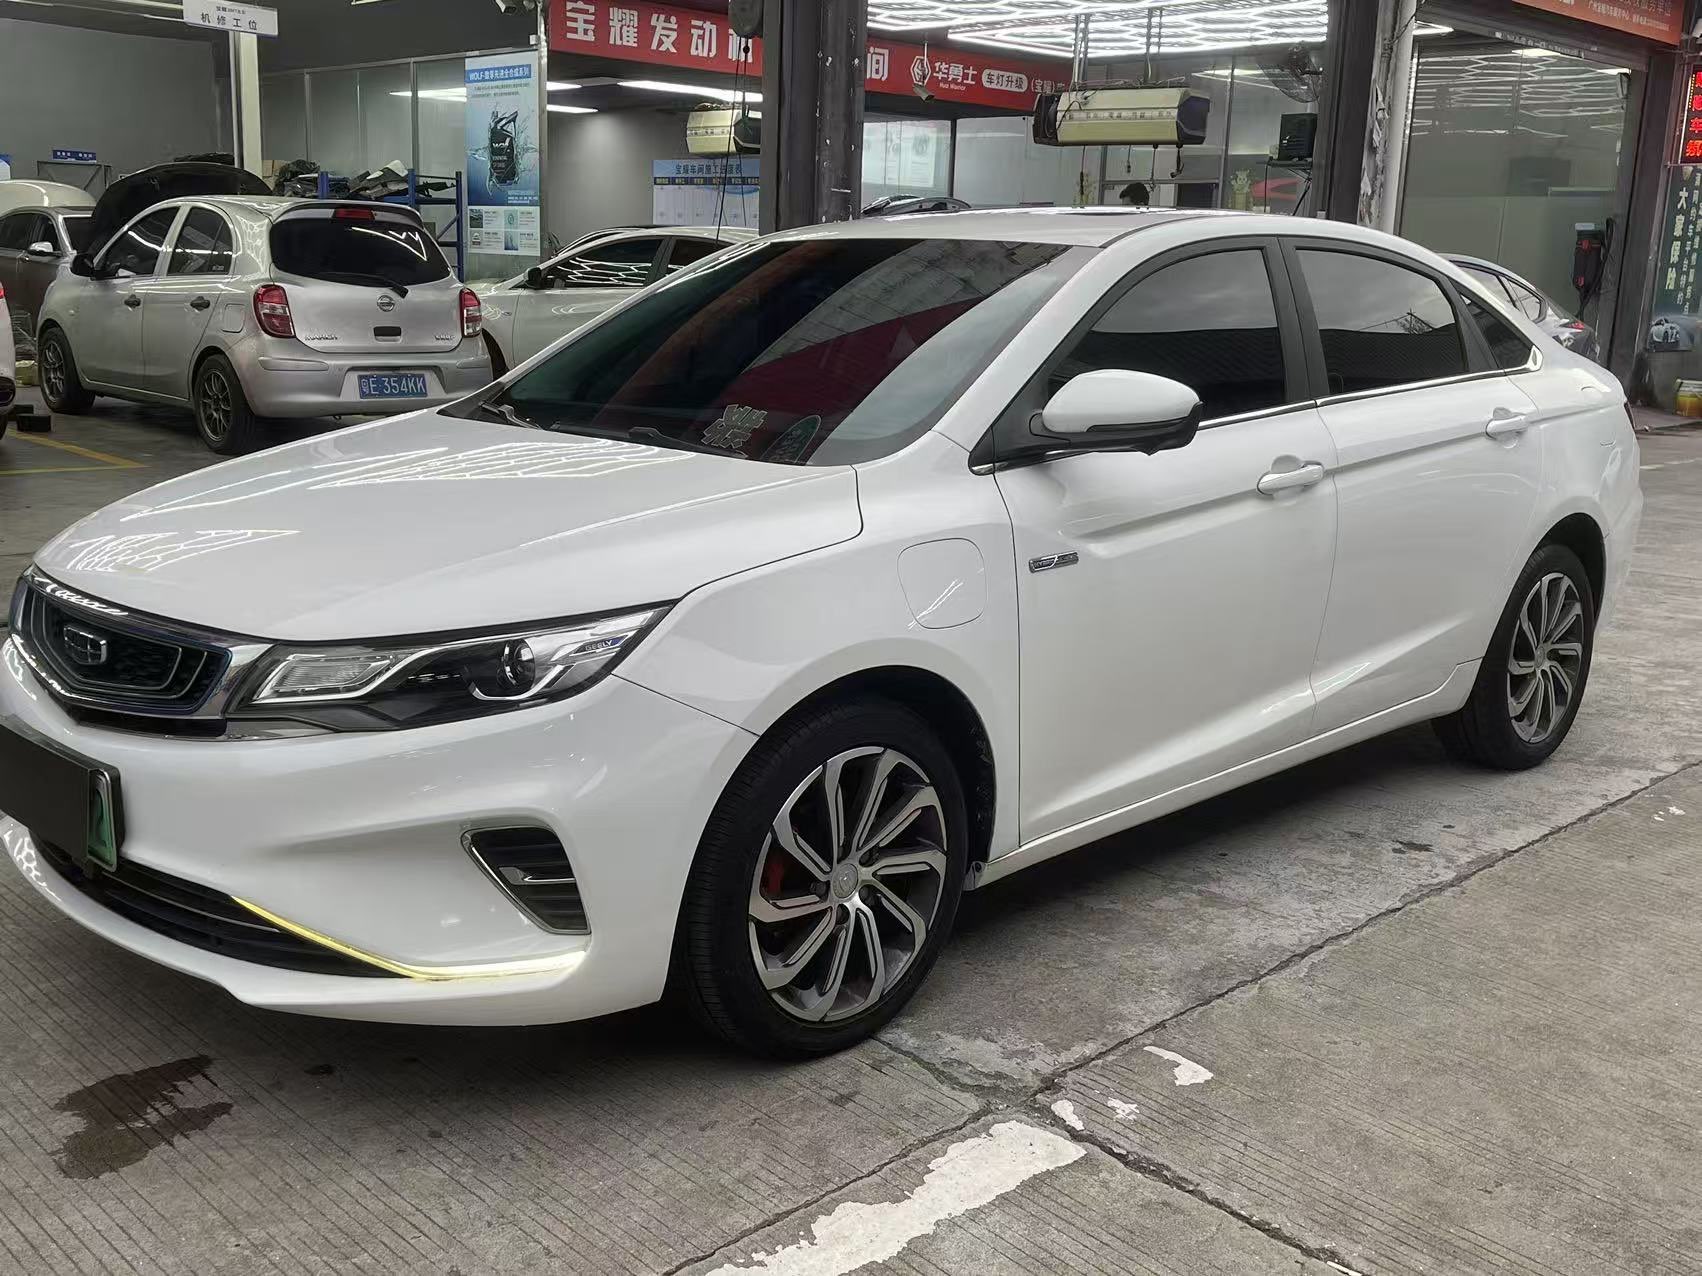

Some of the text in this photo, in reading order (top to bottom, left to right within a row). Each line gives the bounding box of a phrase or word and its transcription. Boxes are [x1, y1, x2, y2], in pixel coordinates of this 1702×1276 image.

[200, 12, 257, 31] 机修工位
[933, 61, 978, 85] 华勇士
[986, 71, 1024, 91] 车灯升级
[585, 640, 612, 651] GEELY
